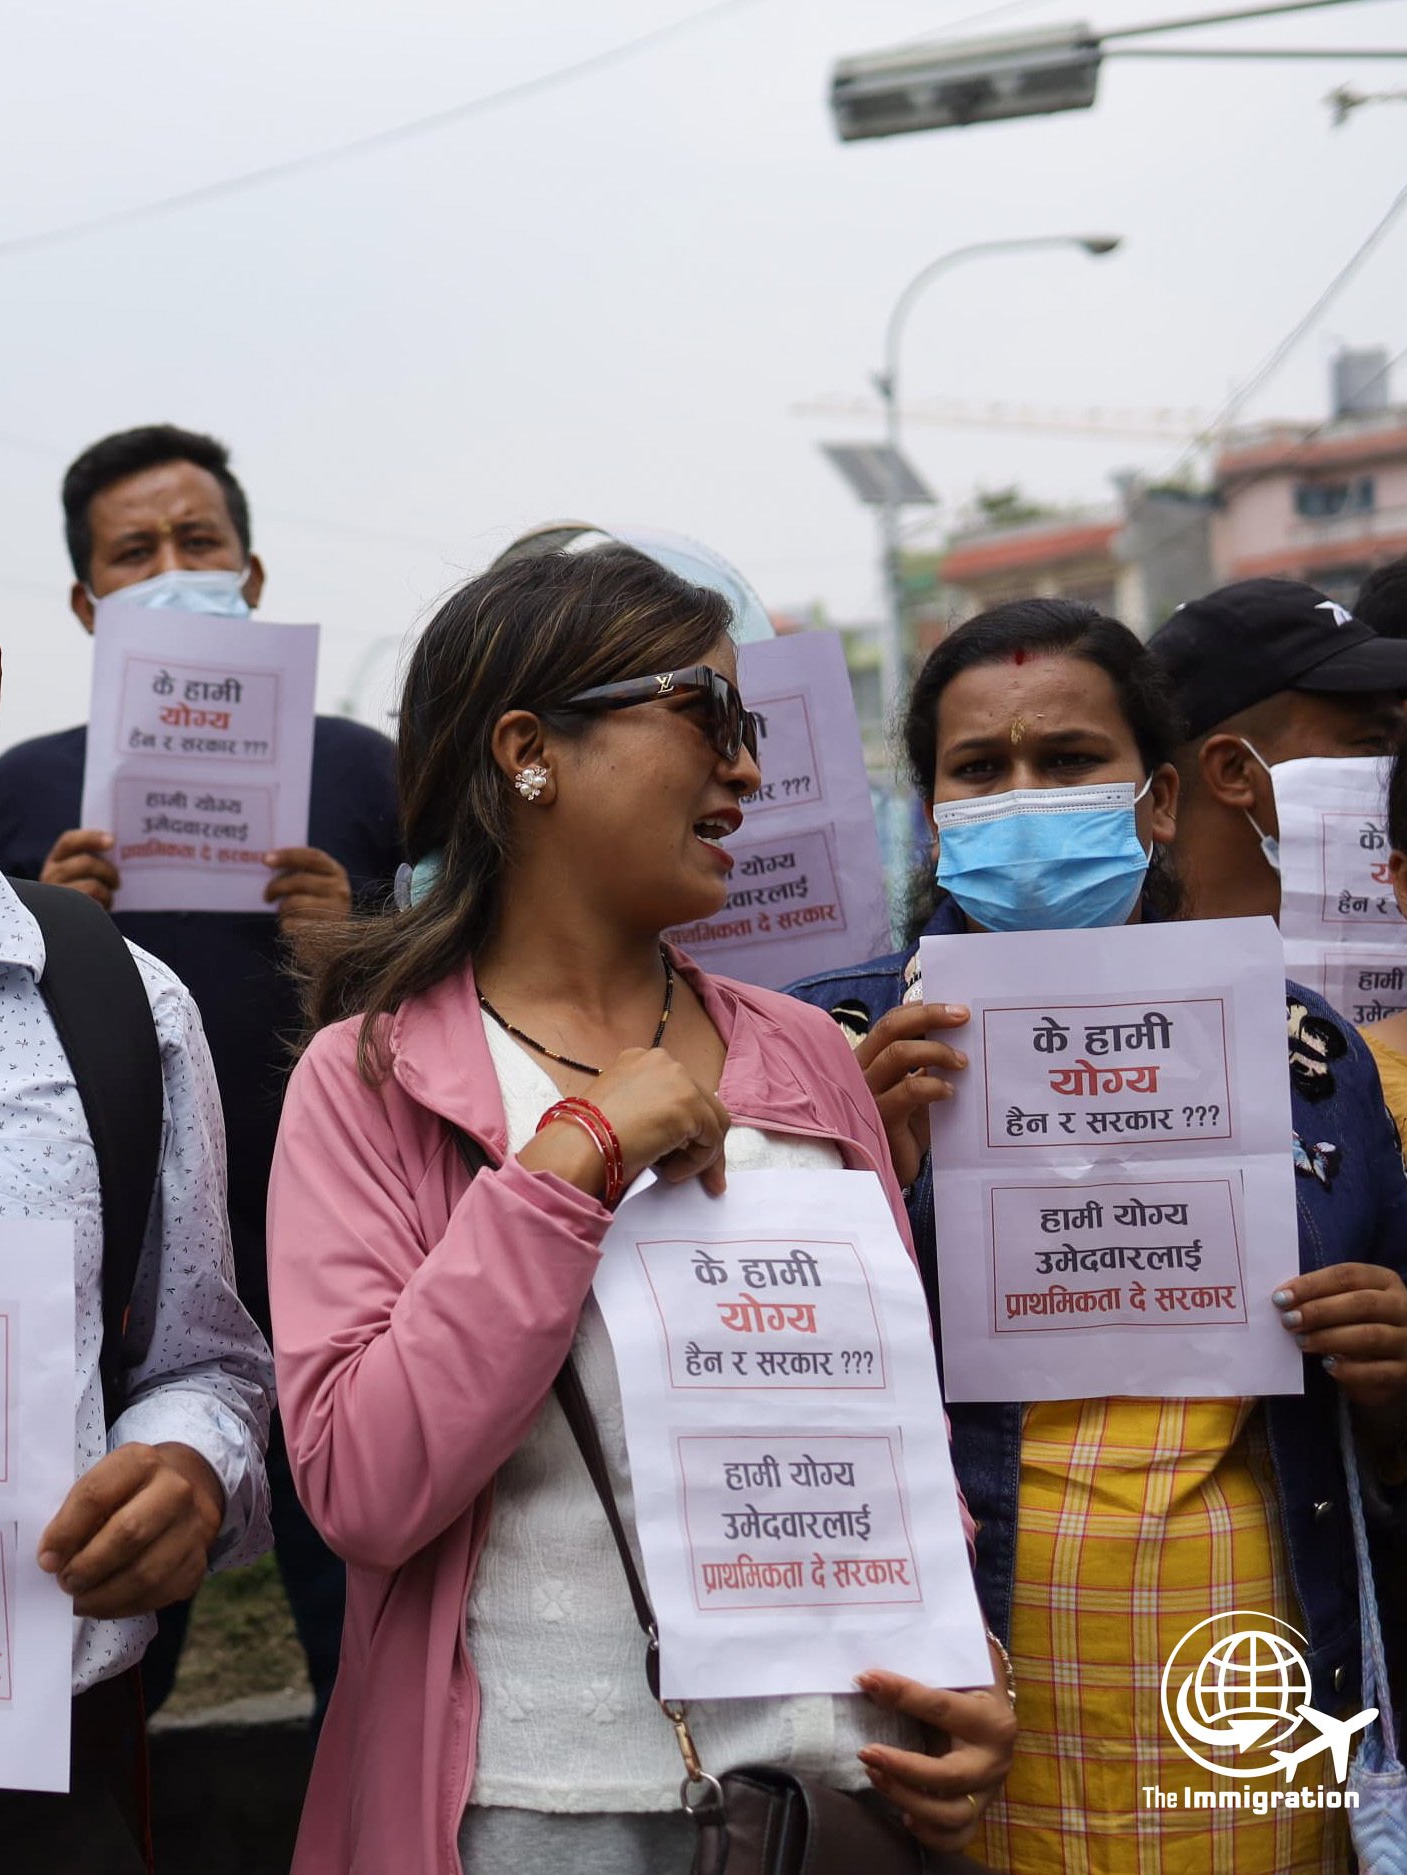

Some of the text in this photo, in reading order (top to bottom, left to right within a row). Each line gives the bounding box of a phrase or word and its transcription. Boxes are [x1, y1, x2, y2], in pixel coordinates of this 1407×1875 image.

[152, 670, 242, 704] के हामी
[160, 703, 232, 729] योग्य
[163, 737, 172, 750] र
[146, 791, 242, 814] हामी योग्य
[782, 776, 811, 796] ???
[1360, 822, 1386, 850] के
[741, 852, 795, 877] योग्य
[758, 916, 771, 933] दे
[777, 904, 838, 928] सरकार
[1338, 889, 1389, 914] हैन र
[1358, 967, 1404, 990] हामी
[1033, 1011, 1174, 1056] के हामी
[1048, 1059, 1160, 1097] योग्य
[1005, 1104, 1220, 1137] हैन र सरकार ???
[1040, 1198, 1189, 1233] हामी योग्य
[691, 1249, 822, 1289] के हामी
[1035, 1239, 1203, 1274] उमेदवारलाई
[717, 1293, 817, 1334] योग्य
[1005, 1280, 1237, 1320] प्राथमिकता दे सरकार
[685, 1341, 874, 1377] हैन र सरकार ???
[723, 1454, 854, 1491] हामी योग्य
[722, 1504, 871, 1542] उमेदवारलाई
[701, 1552, 911, 1595] प्राथमिकता दे सरकार
